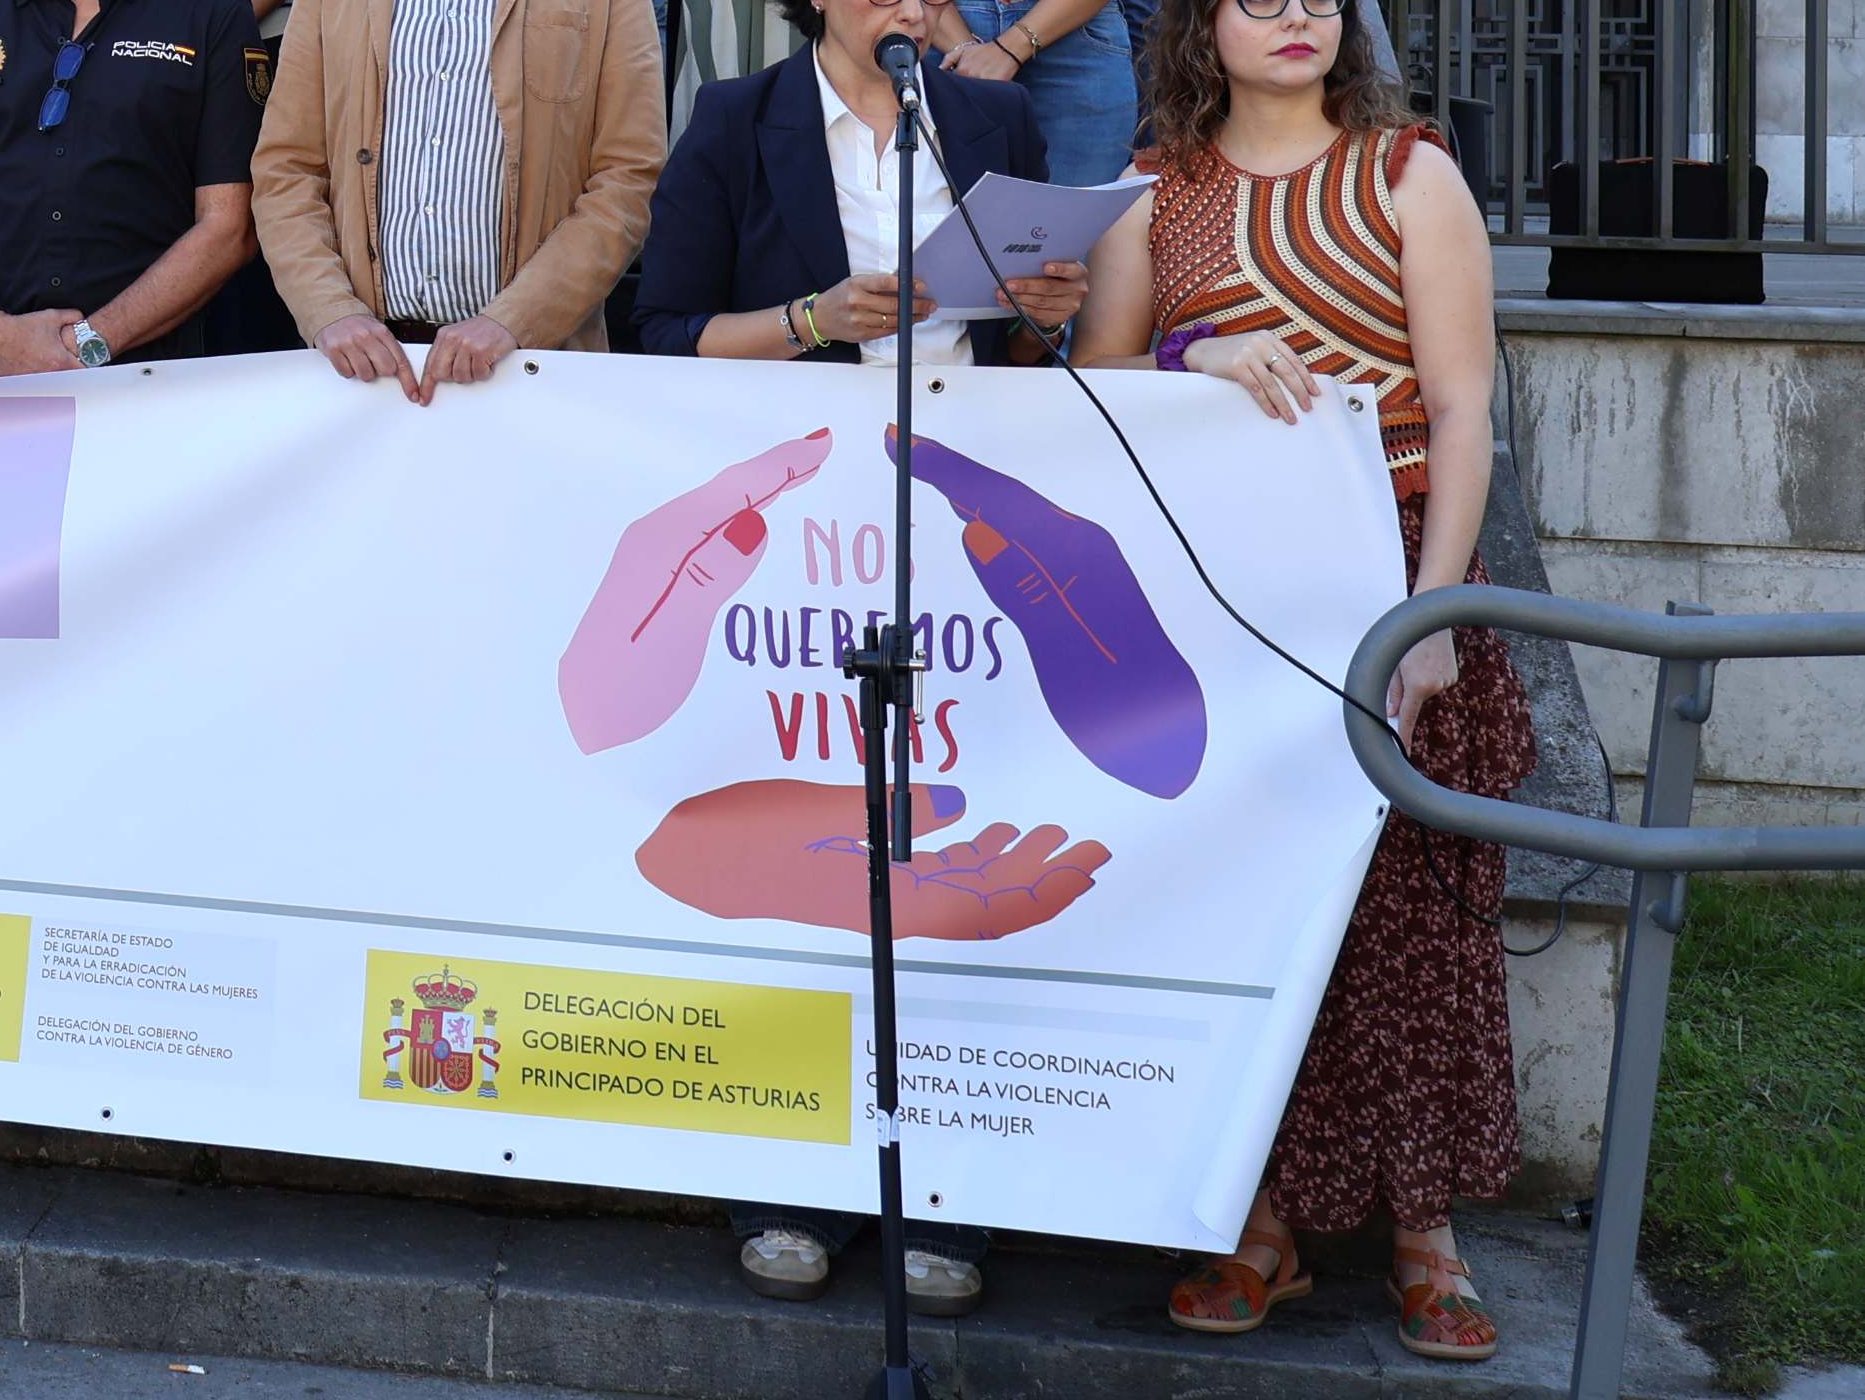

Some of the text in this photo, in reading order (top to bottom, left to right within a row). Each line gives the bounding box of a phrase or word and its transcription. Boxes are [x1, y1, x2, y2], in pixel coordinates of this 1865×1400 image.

[111, 49, 193, 66] NACIONAL
[113, 41, 176, 51] POLICIA
[803, 517, 916, 588] NO
[43, 941, 119, 958] DE IGUALDAD
[44, 927, 173, 949] SECRETARÍA DE ESTADO
[42, 955, 187, 978] Y PARA LA ERRADICACIÓN
[41, 968, 258, 1000] DE LA VIOLENCIA CONTRA LAS MUJERES
[524, 991, 726, 1029] DELEGACIÓN DEL
[36, 1030, 233, 1060] CONTRA LA VIOLENCIA DE GÉNERO
[37, 1016, 198, 1042] DELEGACIÓN DEL GOBIERNO
[522, 1029, 647, 1059] GOBIERNO
[655, 1042, 687, 1063] EN
[695, 1045, 719, 1065] EL
[866, 1039, 1175, 1084] UIDAD DE COORDINACIÓN
[521, 1067, 820, 1112] PRINCIPADO DE ASTURIAS
[866, 1071, 1111, 1110] CNTRA LA VIOLENCIA
[866, 1103, 1035, 1137] SBRE LA MUJER
